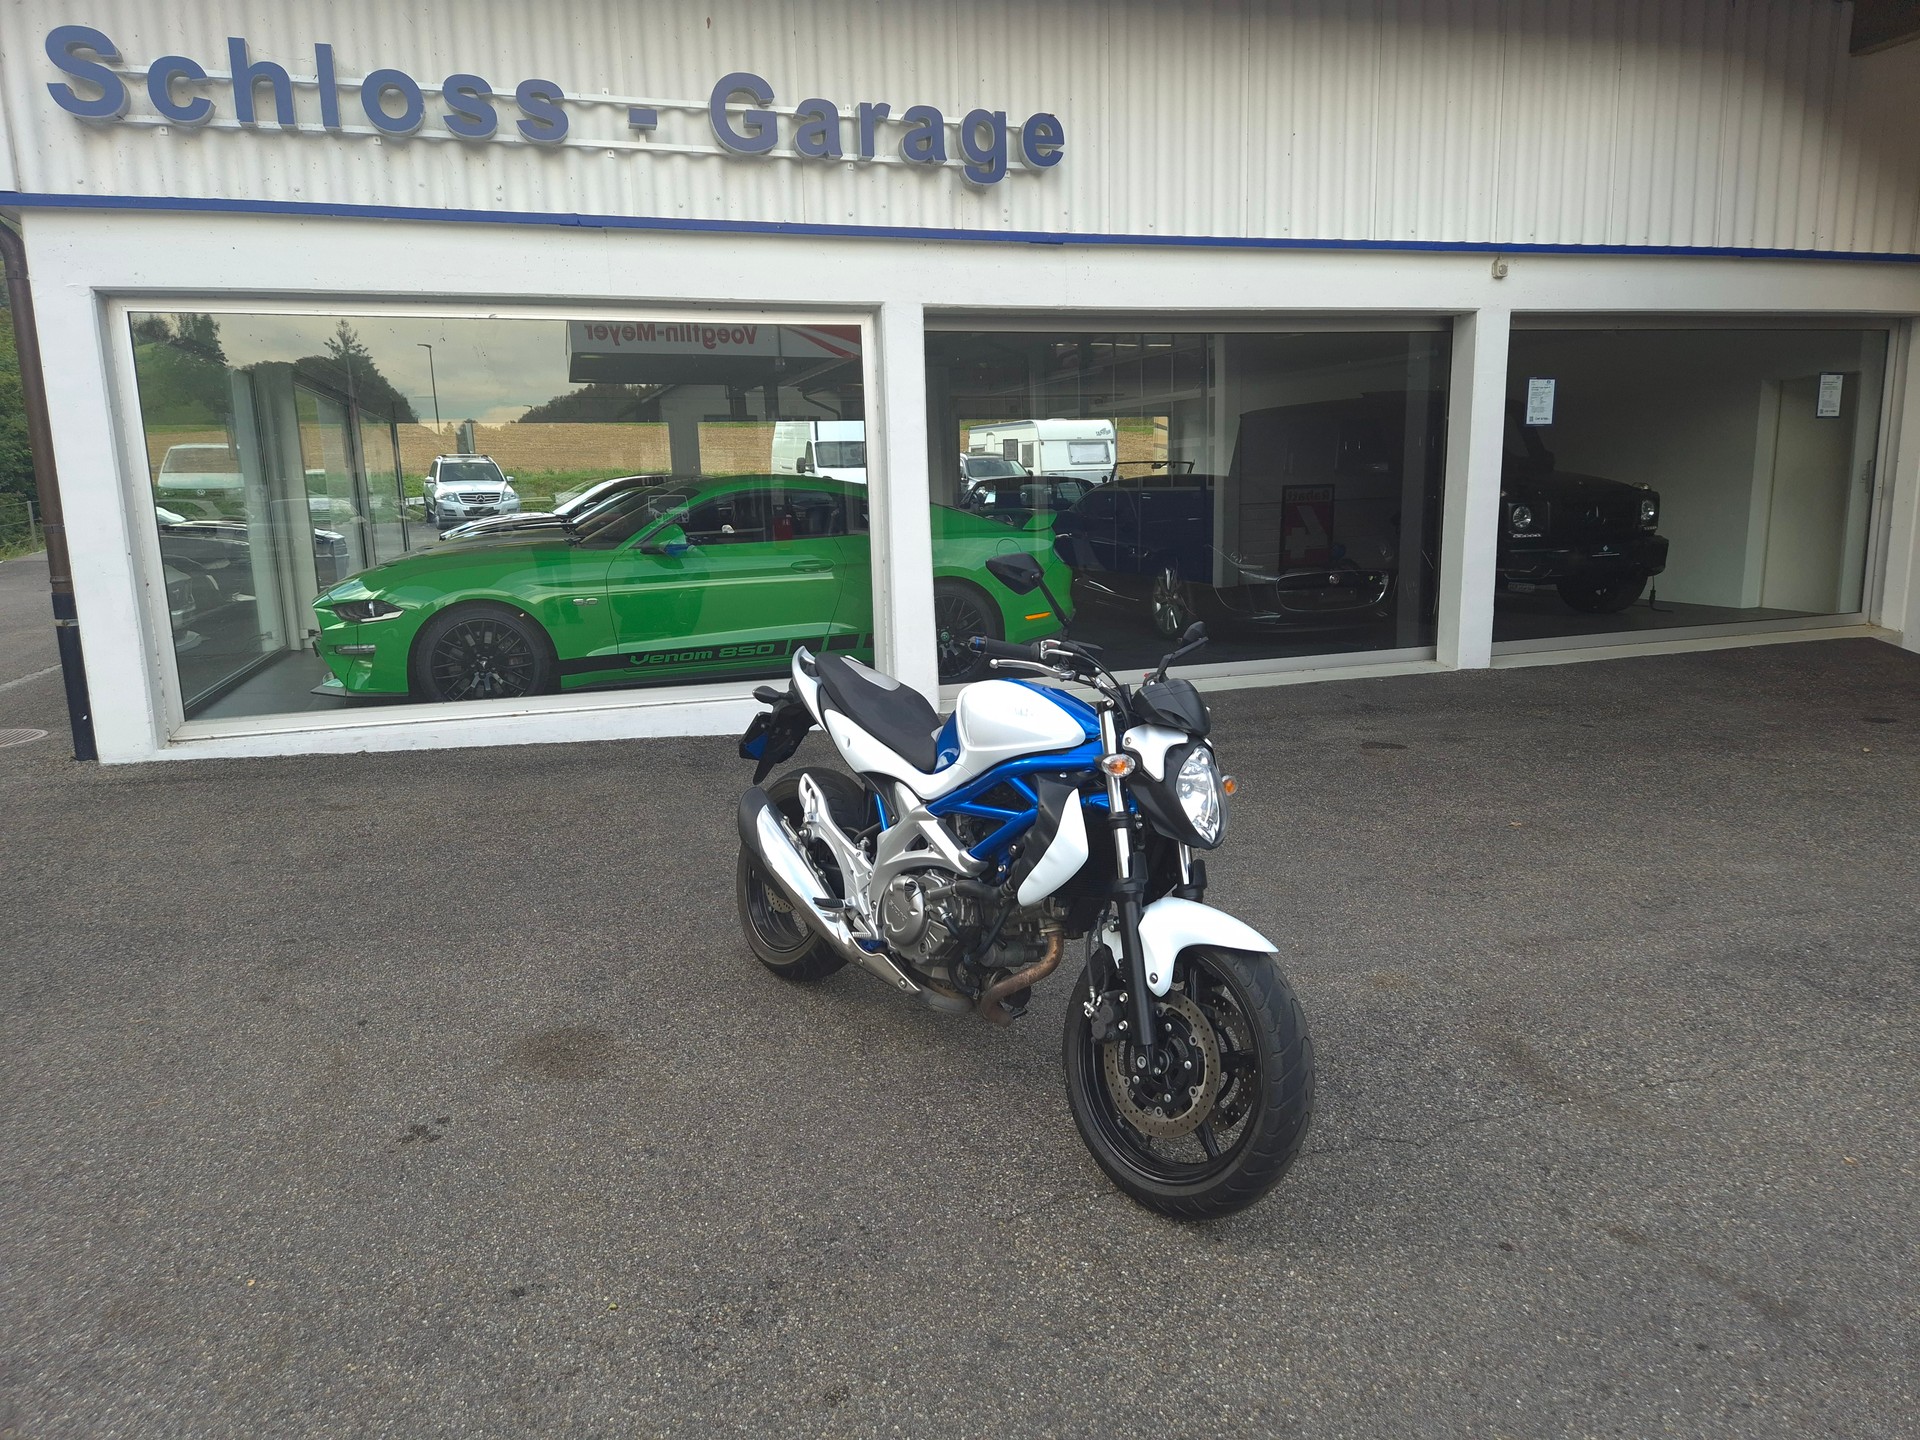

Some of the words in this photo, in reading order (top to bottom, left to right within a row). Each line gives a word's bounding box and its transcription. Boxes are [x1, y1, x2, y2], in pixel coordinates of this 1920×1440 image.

[45, 25, 570, 144] Schloss
[709, 72, 1066, 186] Garage
[630, 650, 713, 665] Venom
[718, 643, 775, 658] 850
